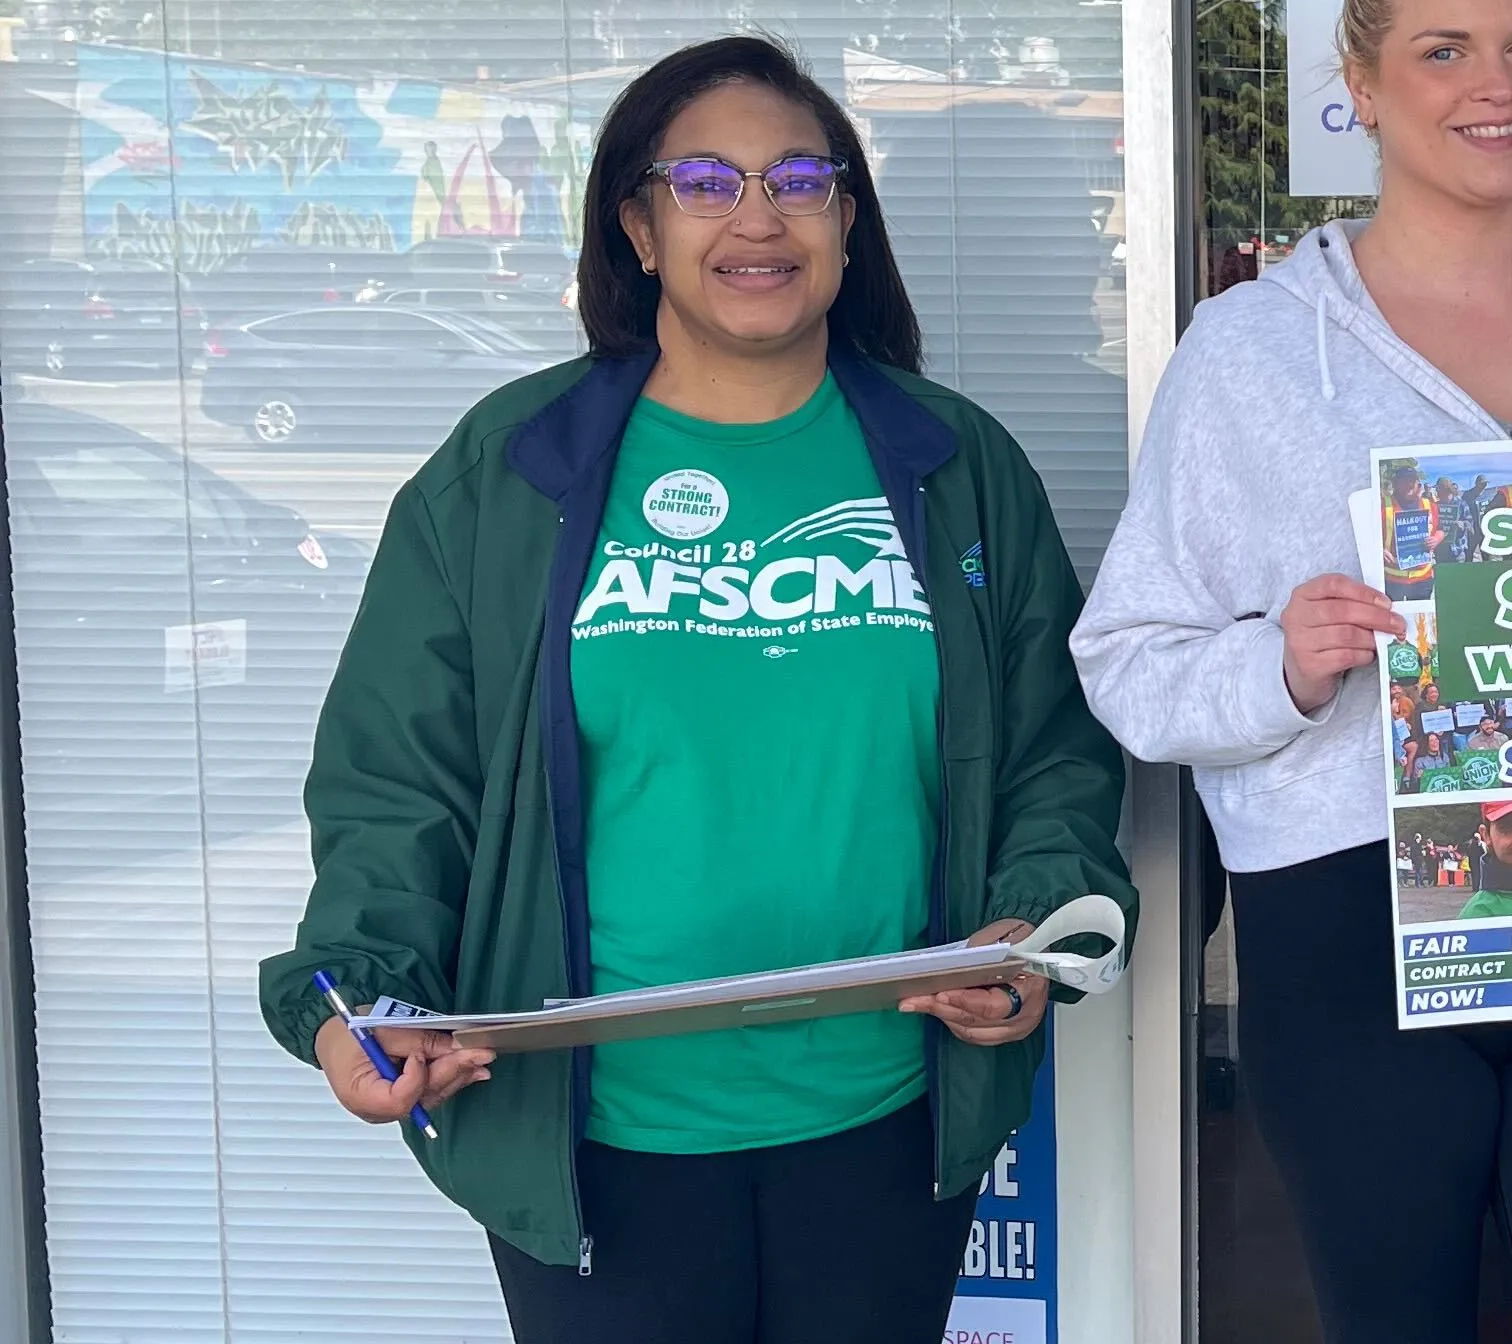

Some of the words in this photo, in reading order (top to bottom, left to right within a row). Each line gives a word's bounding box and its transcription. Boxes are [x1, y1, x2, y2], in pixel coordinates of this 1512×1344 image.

[661, 488, 713, 504] STRONG
[648, 499, 721, 518] CONTRACT!
[604, 540, 711, 563] Council
[722, 540, 756, 564] 28
[573, 555, 931, 625] AFSCME
[572, 617, 683, 641] Washington
[685, 618, 783, 638] Federation
[787, 619, 807, 635] of
[811, 614, 861, 632] State
[866, 612, 935, 633] Employe
[1408, 934, 1468, 957] FAIR
[1409, 960, 1505, 982] CONTRACT
[1411, 989, 1486, 1012] NOW!
[959, 1219, 1035, 1280] BLE!
